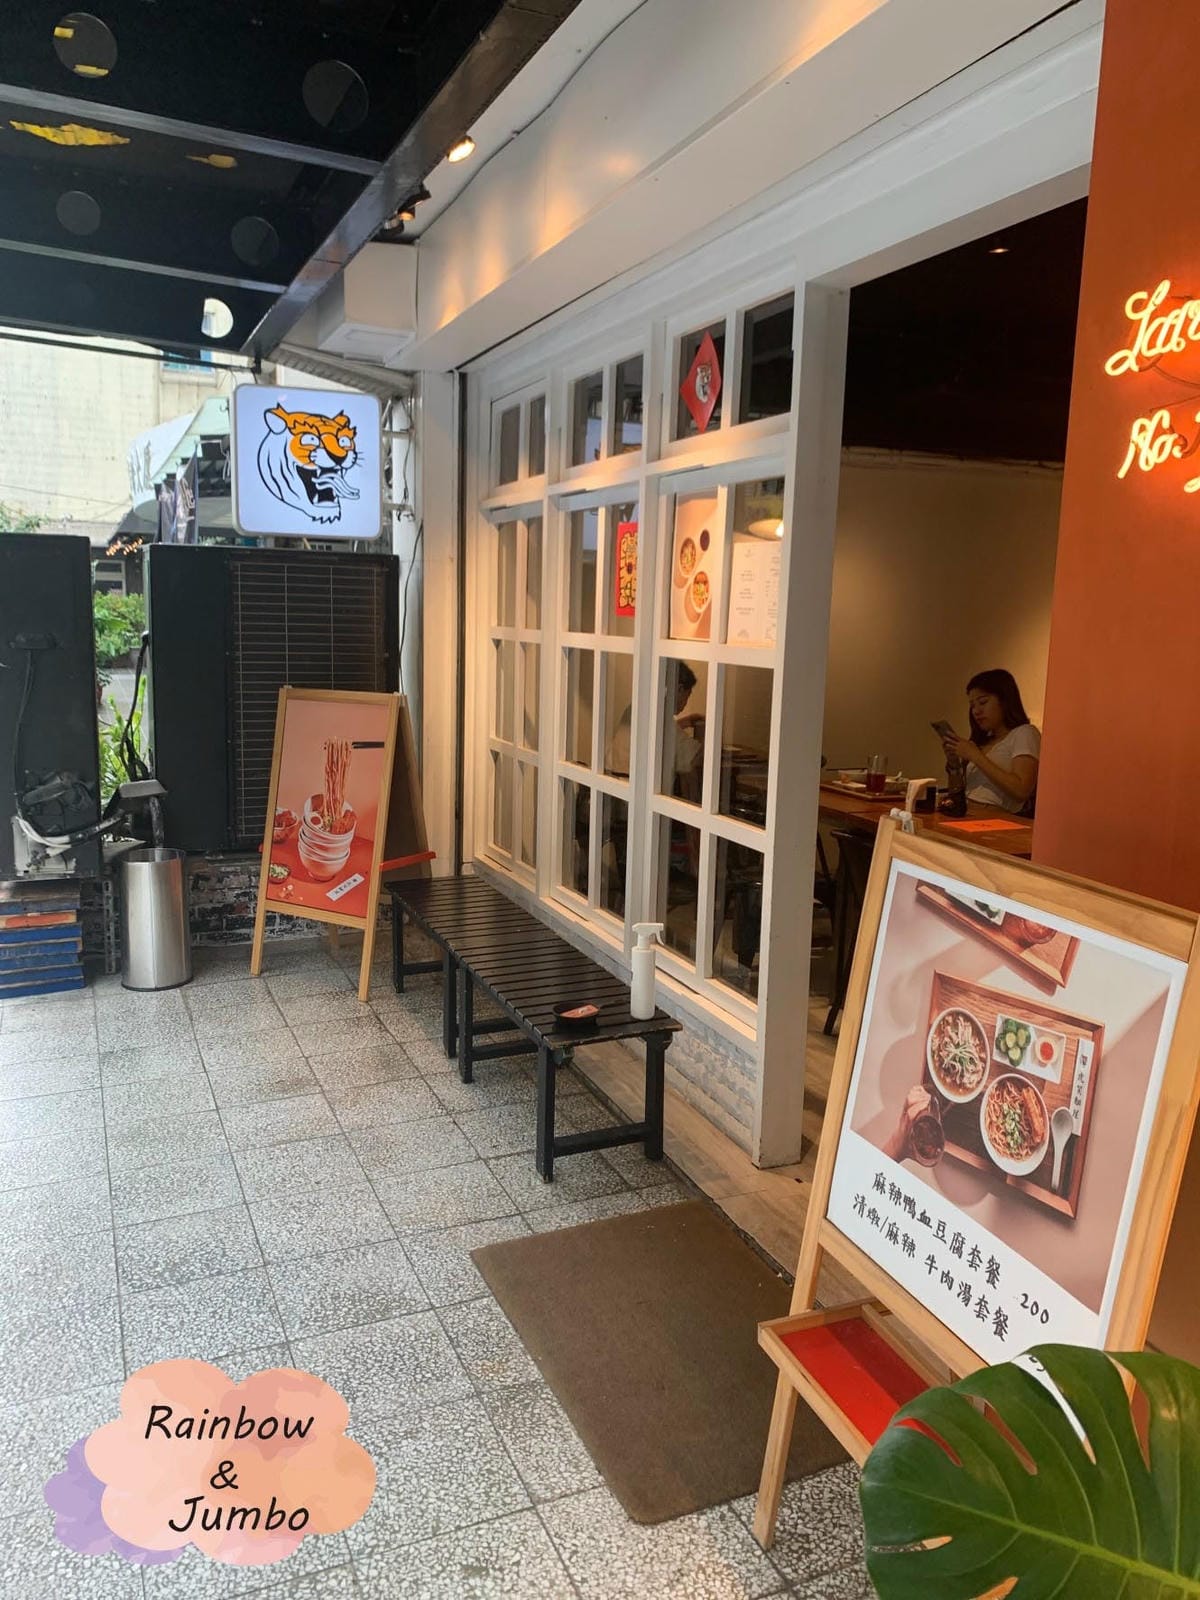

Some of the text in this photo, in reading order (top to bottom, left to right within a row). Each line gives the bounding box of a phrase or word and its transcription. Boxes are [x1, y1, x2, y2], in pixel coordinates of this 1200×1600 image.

[871, 1172, 1050, 1325] 麻辣鴨血豆腐套餐 200
[923, 1254, 1010, 1342] 牛肉湯套餐
